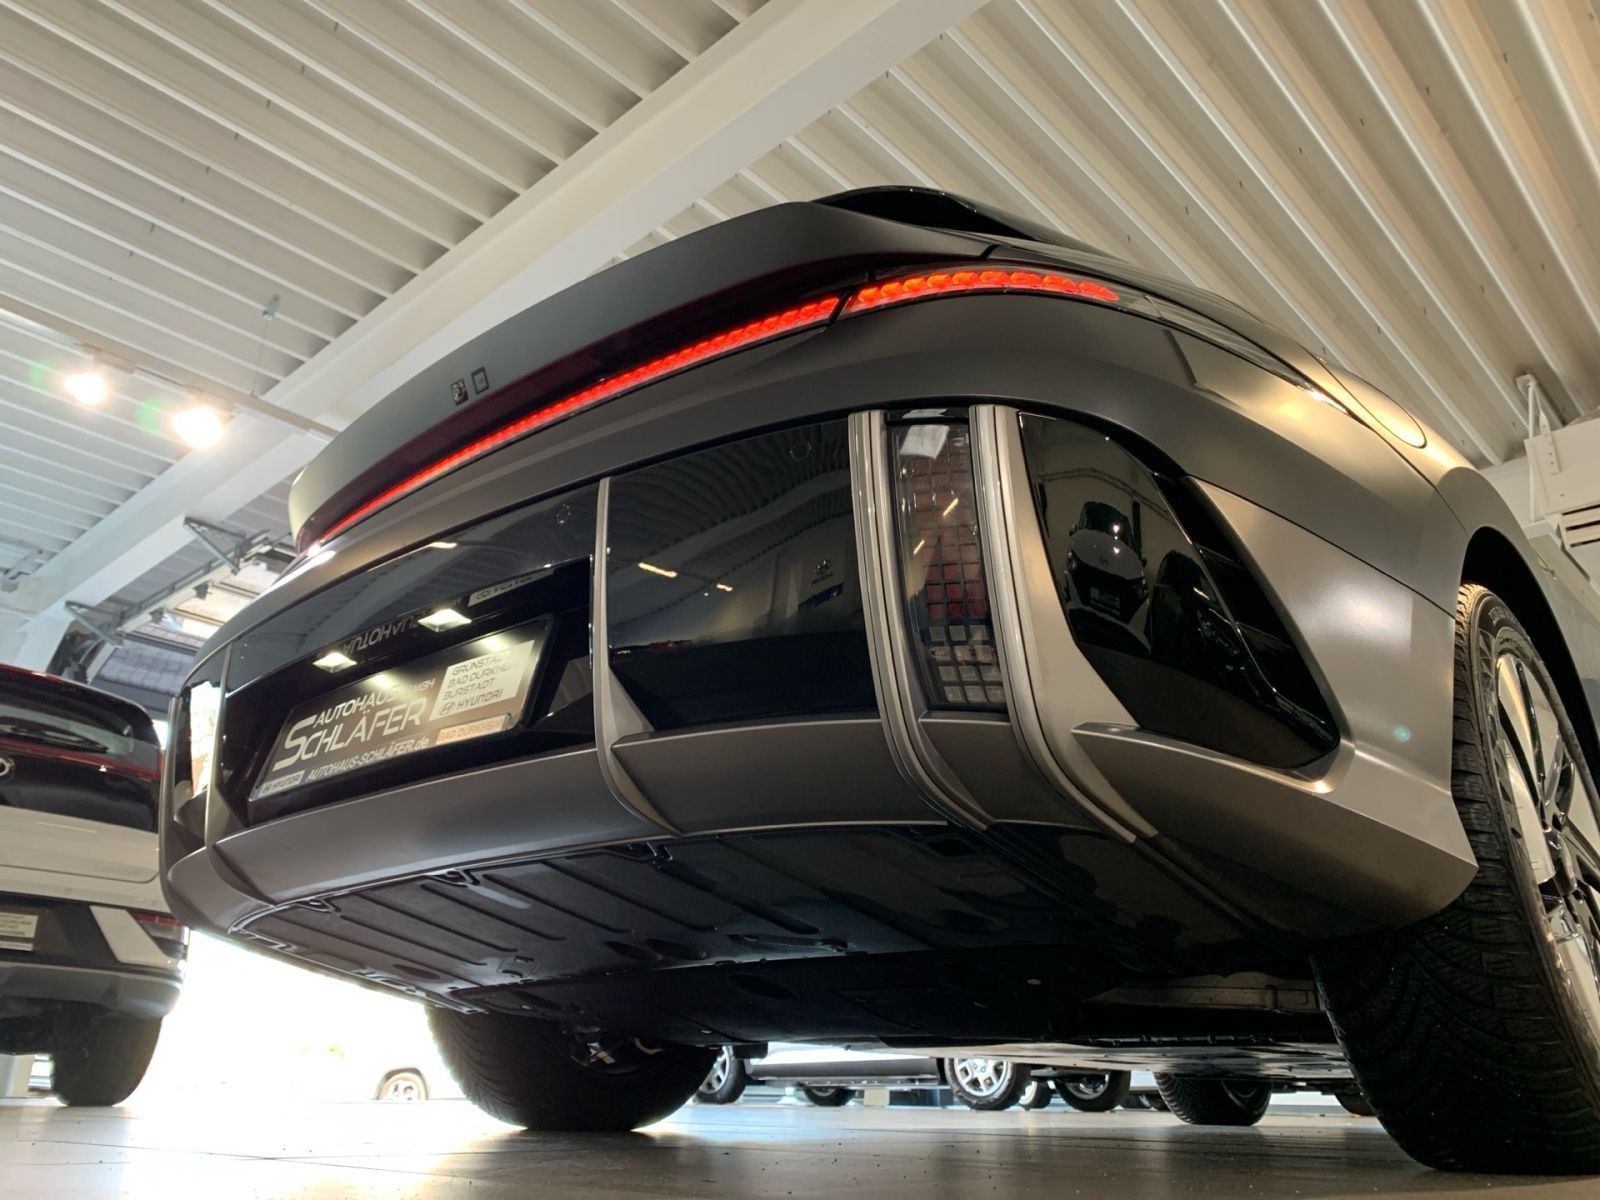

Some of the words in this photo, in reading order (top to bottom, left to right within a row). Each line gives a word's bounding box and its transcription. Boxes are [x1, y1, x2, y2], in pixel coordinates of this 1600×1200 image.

[448, 674, 469, 689] BAD
[456, 689, 503, 710] HYUNDAI
[272, 697, 427, 772] SCHLÄFER
